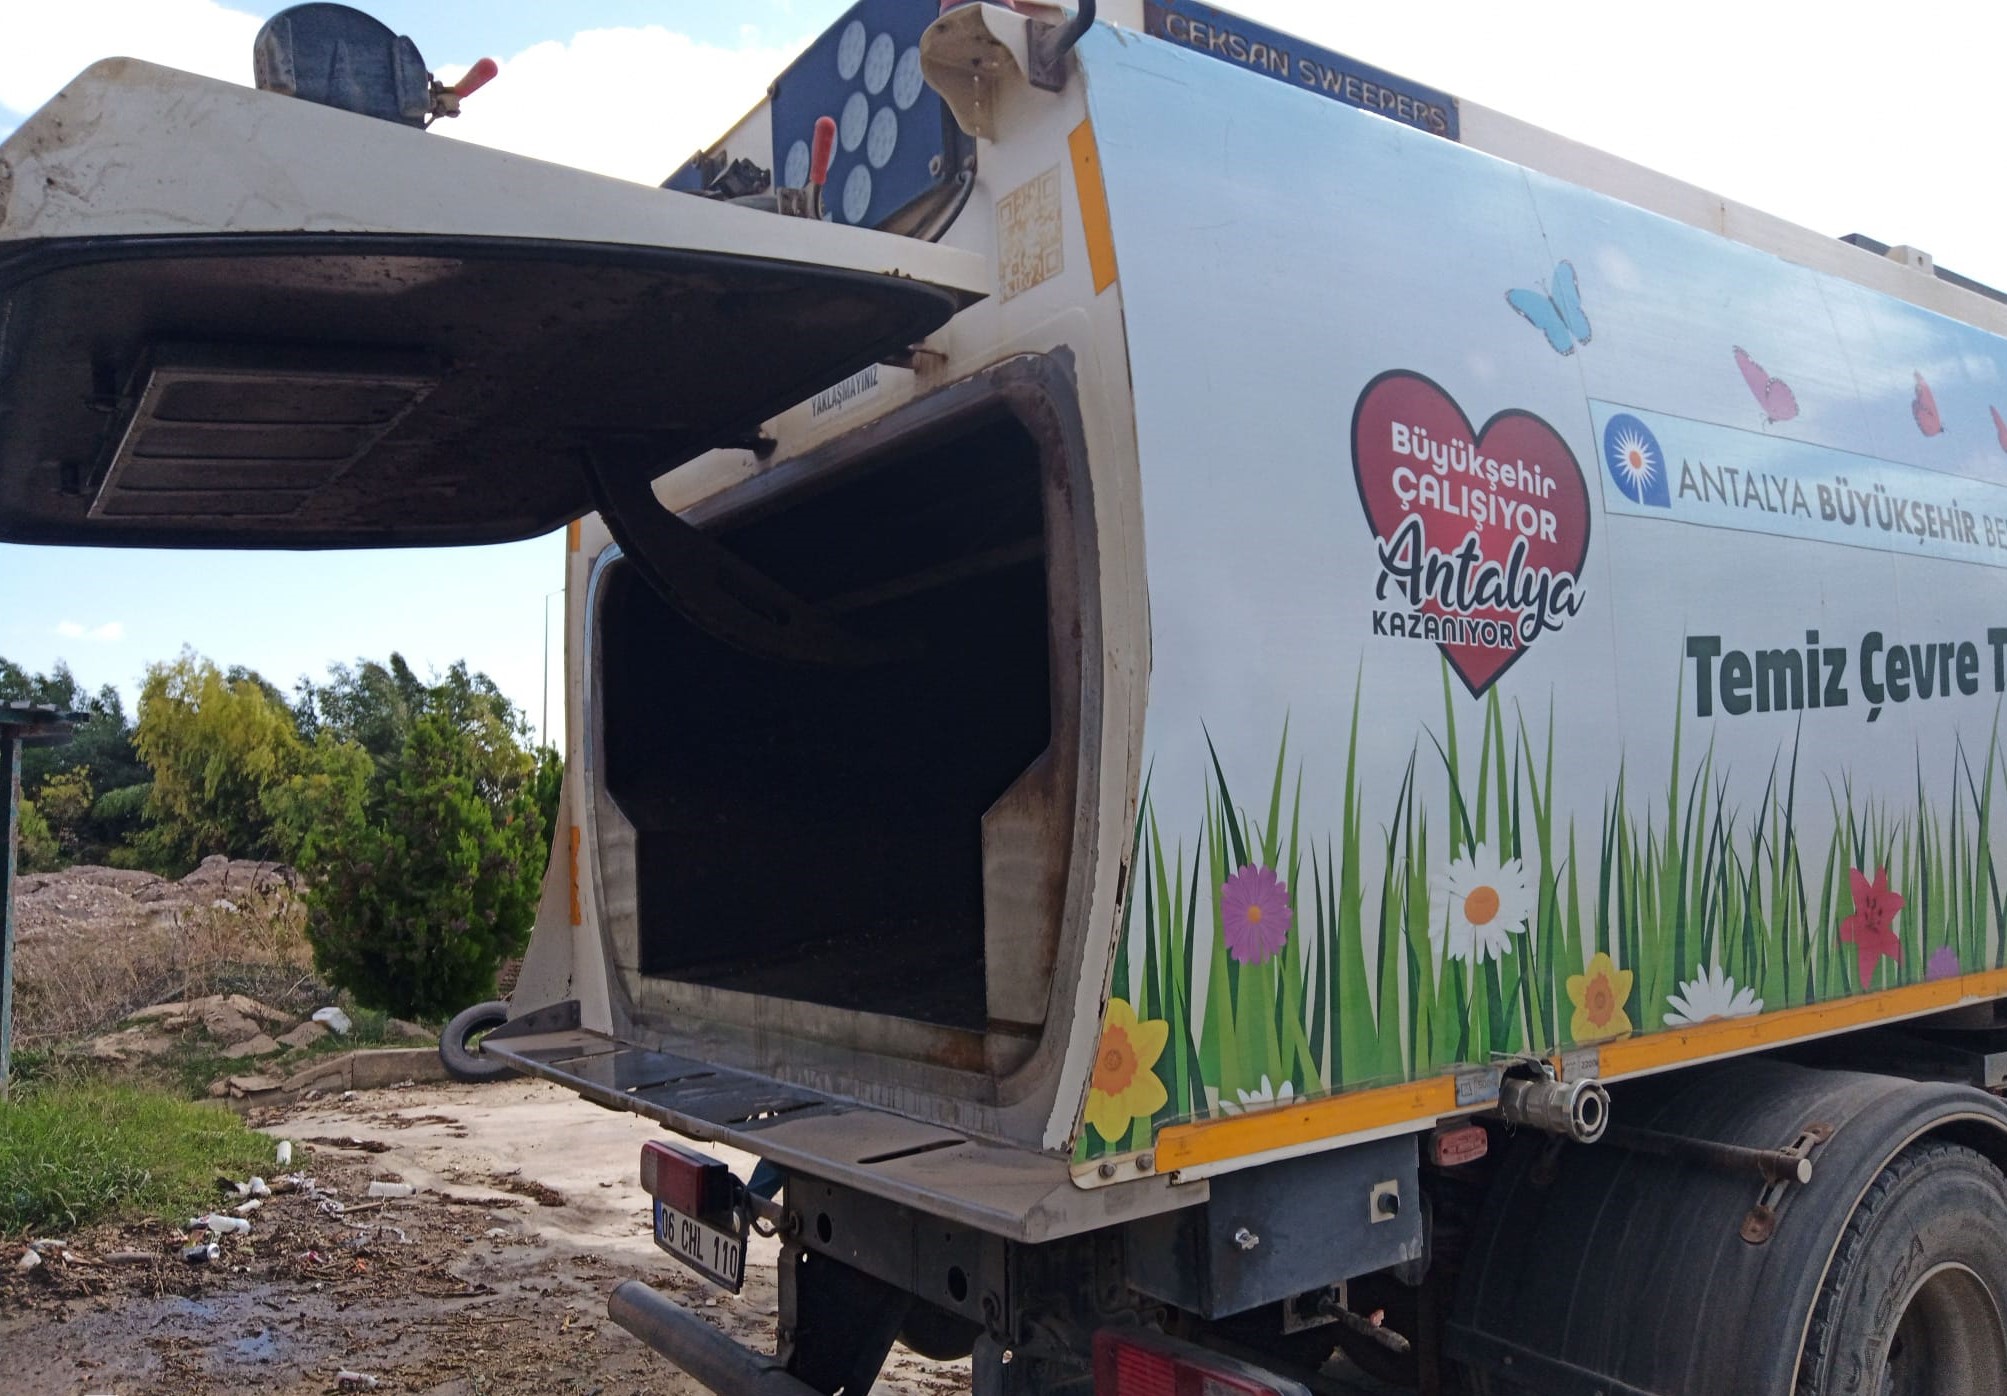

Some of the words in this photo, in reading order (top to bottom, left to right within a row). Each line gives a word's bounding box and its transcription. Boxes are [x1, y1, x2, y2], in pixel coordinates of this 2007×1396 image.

[1299, 58, 1447, 131] SWEEPERS
[1391, 420, 1557, 498] Büyükşehir
[1391, 466, 1558, 543] ÇALIŞIYOR
[1677, 457, 1812, 519] ANTALYA
[1815, 475, 1980, 545] BÜYÜKŞEHİR
[1982, 514, 2007, 551] BE
[1374, 516, 1588, 645] Antalya
[1371, 609, 1516, 650] KAZANIYOR
[1685, 628, 1849, 718] Temiz
[1859, 630, 1980, 723] Çevre
[661, 1208, 675, 1243] 06
[681, 1219, 704, 1262] CHL
[713, 1235, 738, 1279] 110
